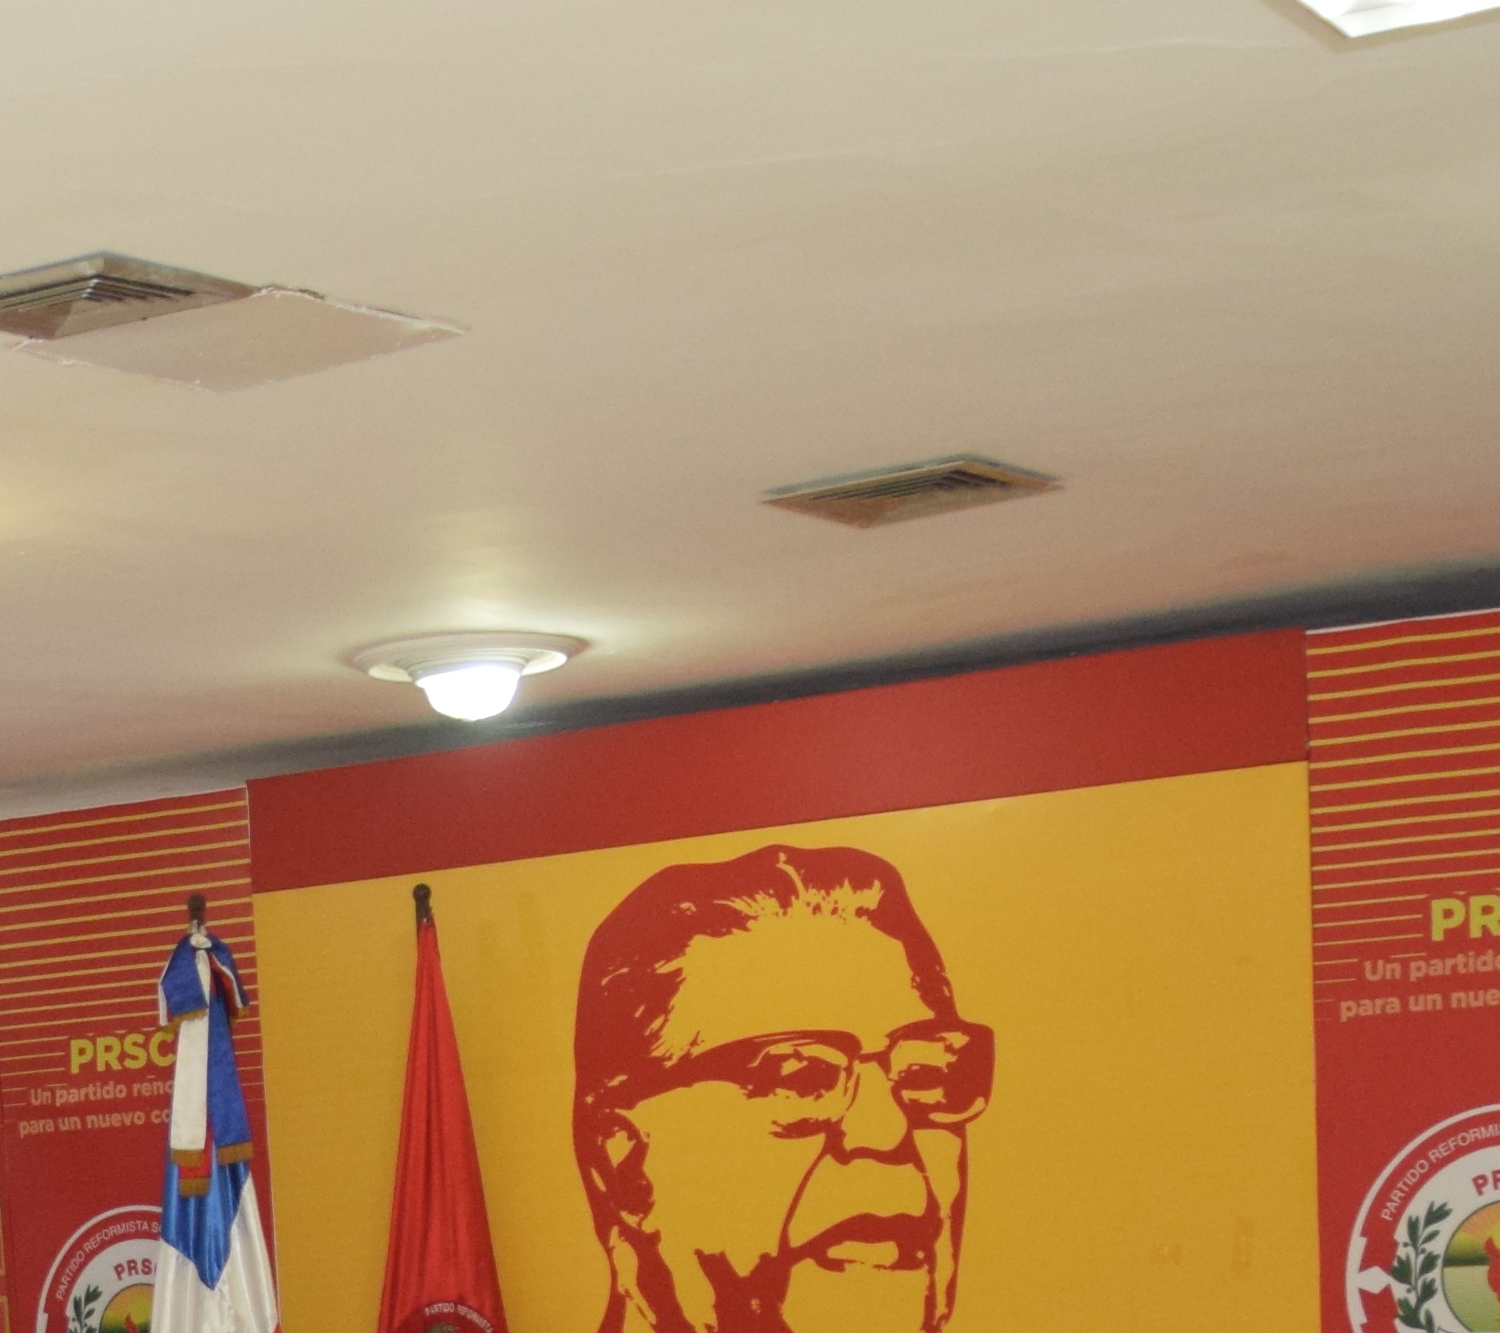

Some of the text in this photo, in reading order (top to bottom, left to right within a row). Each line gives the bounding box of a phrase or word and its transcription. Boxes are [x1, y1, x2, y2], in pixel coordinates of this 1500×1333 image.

[1363, 960, 1401, 982] Un
[1339, 996, 1401, 1023] para
[1408, 991, 1443, 1012] un
[70, 1031, 176, 1074] PRSC
[30, 1080, 174, 1107] Un partido reno
[19, 1117, 55, 1138] para
[58, 1116, 81, 1131] un
[86, 1111, 145, 1129] nuevo
[1381, 1159, 1430, 1221] PARTIDO
[55, 1220, 149, 1300] PARTIDO REFORMISTA
[113, 1257, 156, 1281] PRS
